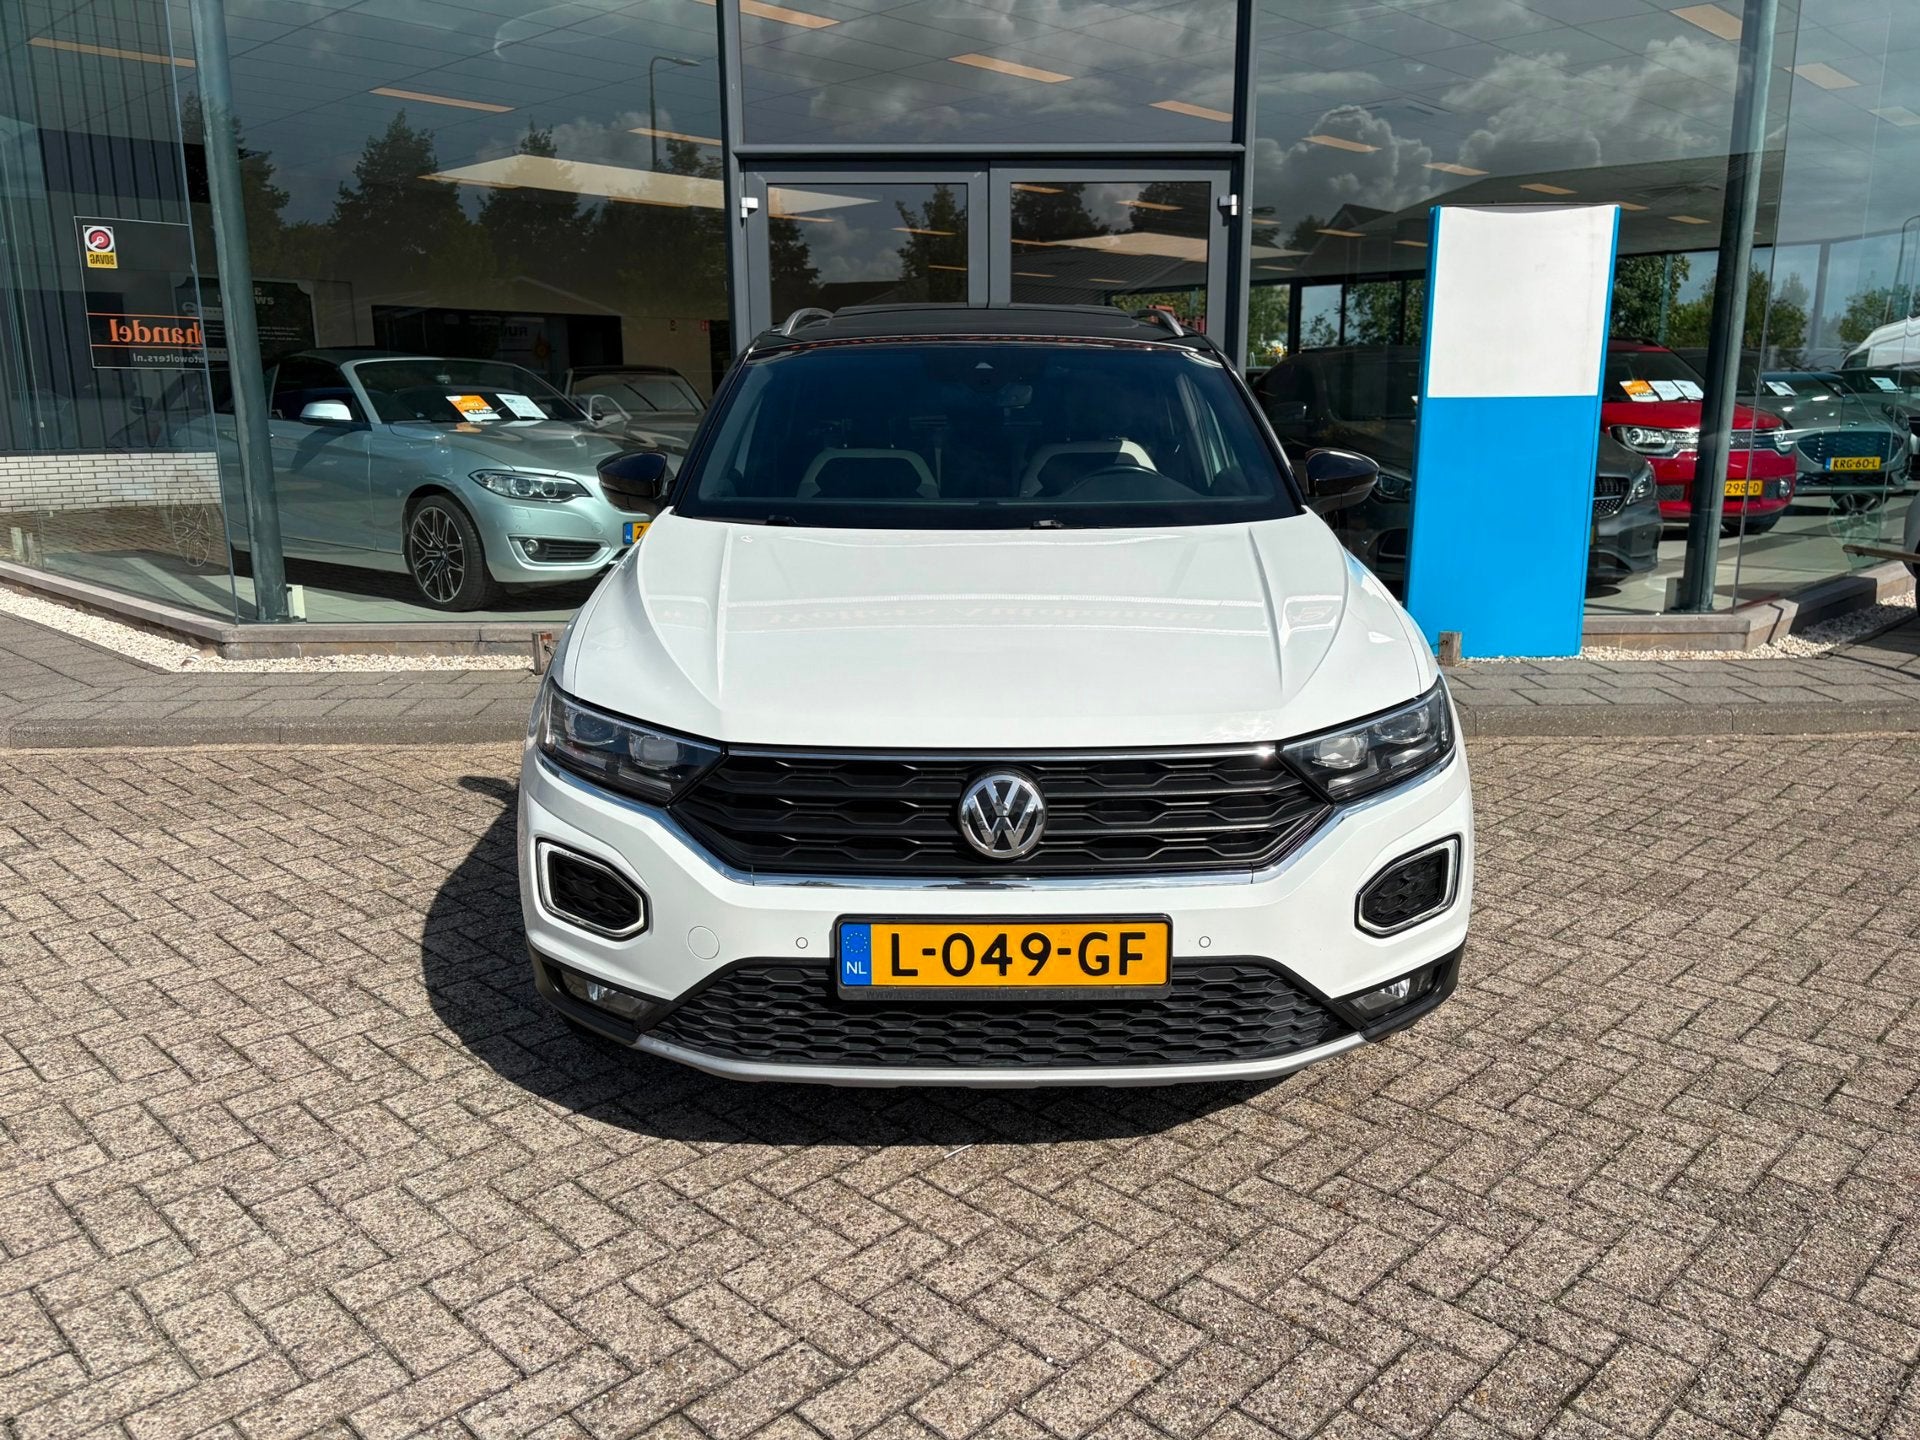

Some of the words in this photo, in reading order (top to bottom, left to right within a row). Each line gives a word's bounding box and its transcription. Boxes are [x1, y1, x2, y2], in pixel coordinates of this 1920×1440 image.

[1833, 458, 1877, 469] KRG-60-L
[891, 932, 1146, 977] L-049-GF
[846, 961, 867, 975] NL
